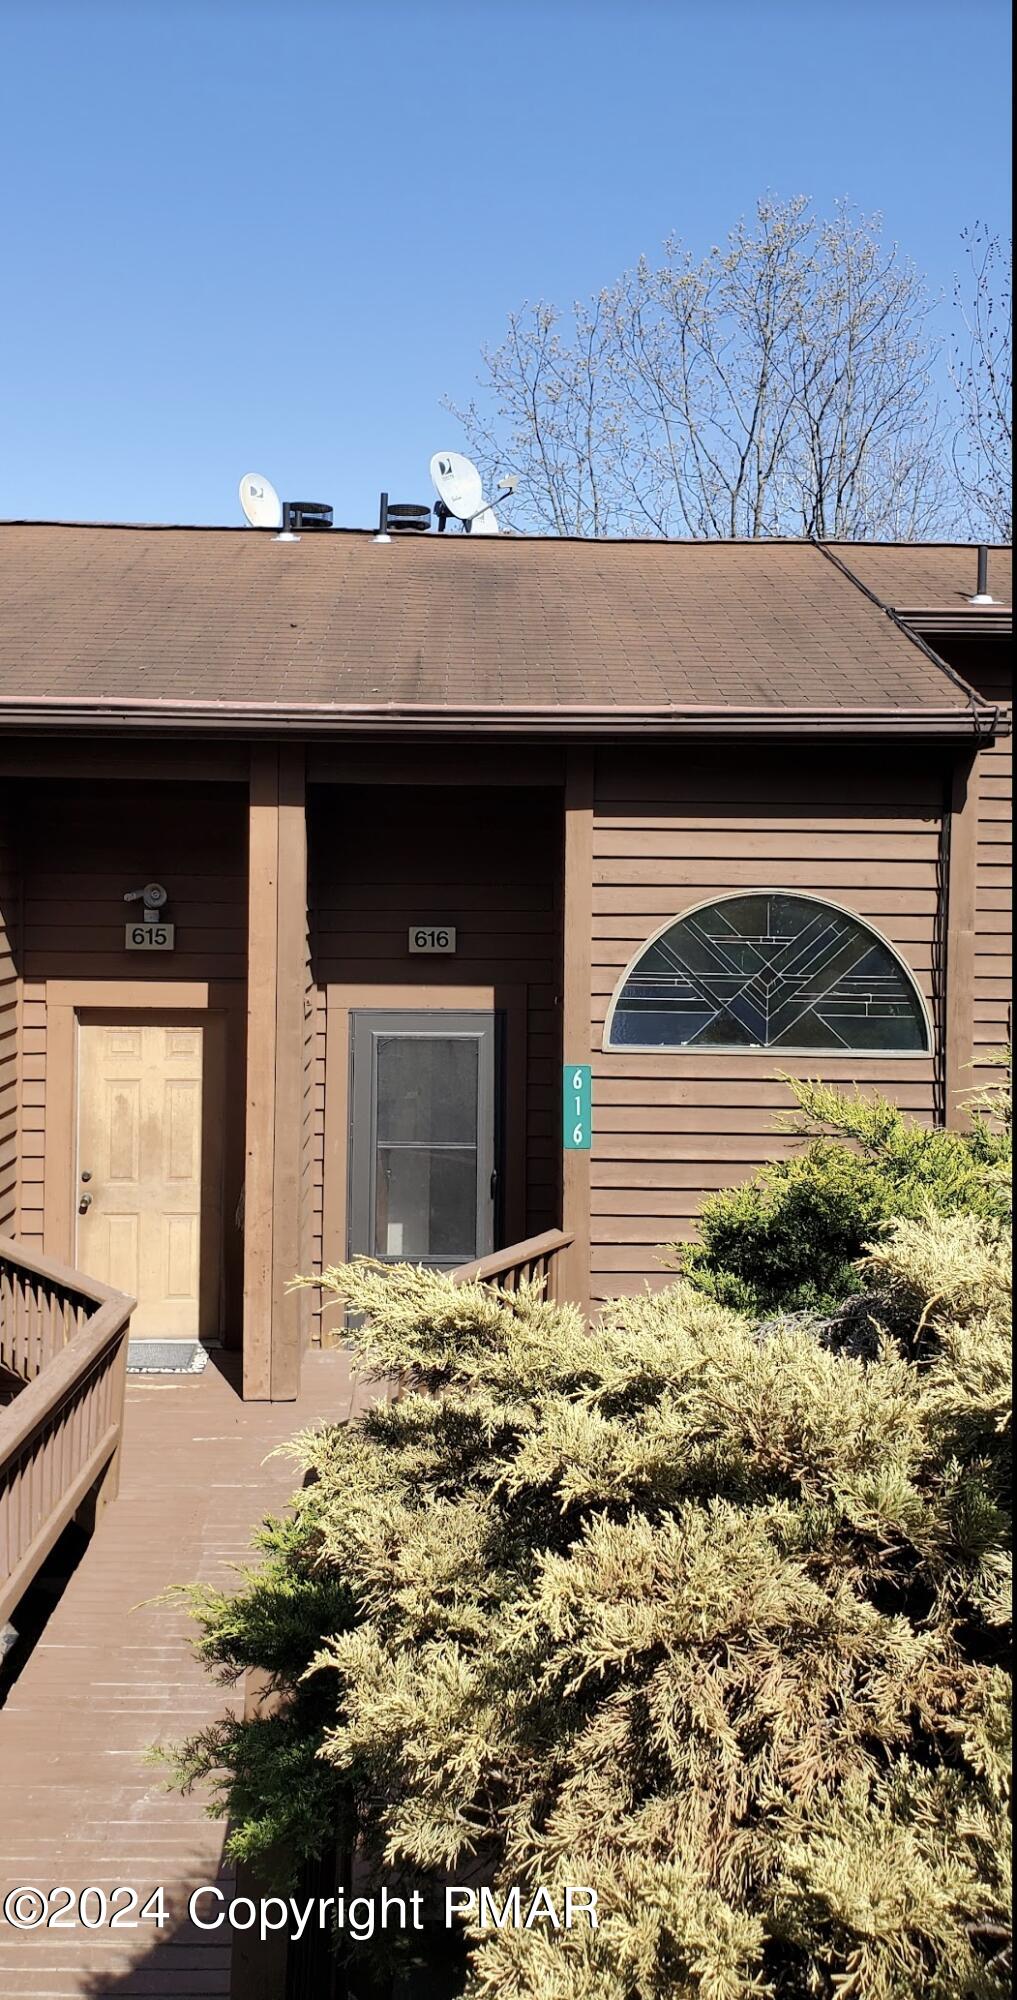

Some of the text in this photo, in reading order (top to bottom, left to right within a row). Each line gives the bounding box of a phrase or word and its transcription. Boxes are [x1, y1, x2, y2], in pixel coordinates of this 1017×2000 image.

[132, 927, 167, 945] 615
[414, 930, 449, 948] 616
[572, 1069, 583, 1145] 616
